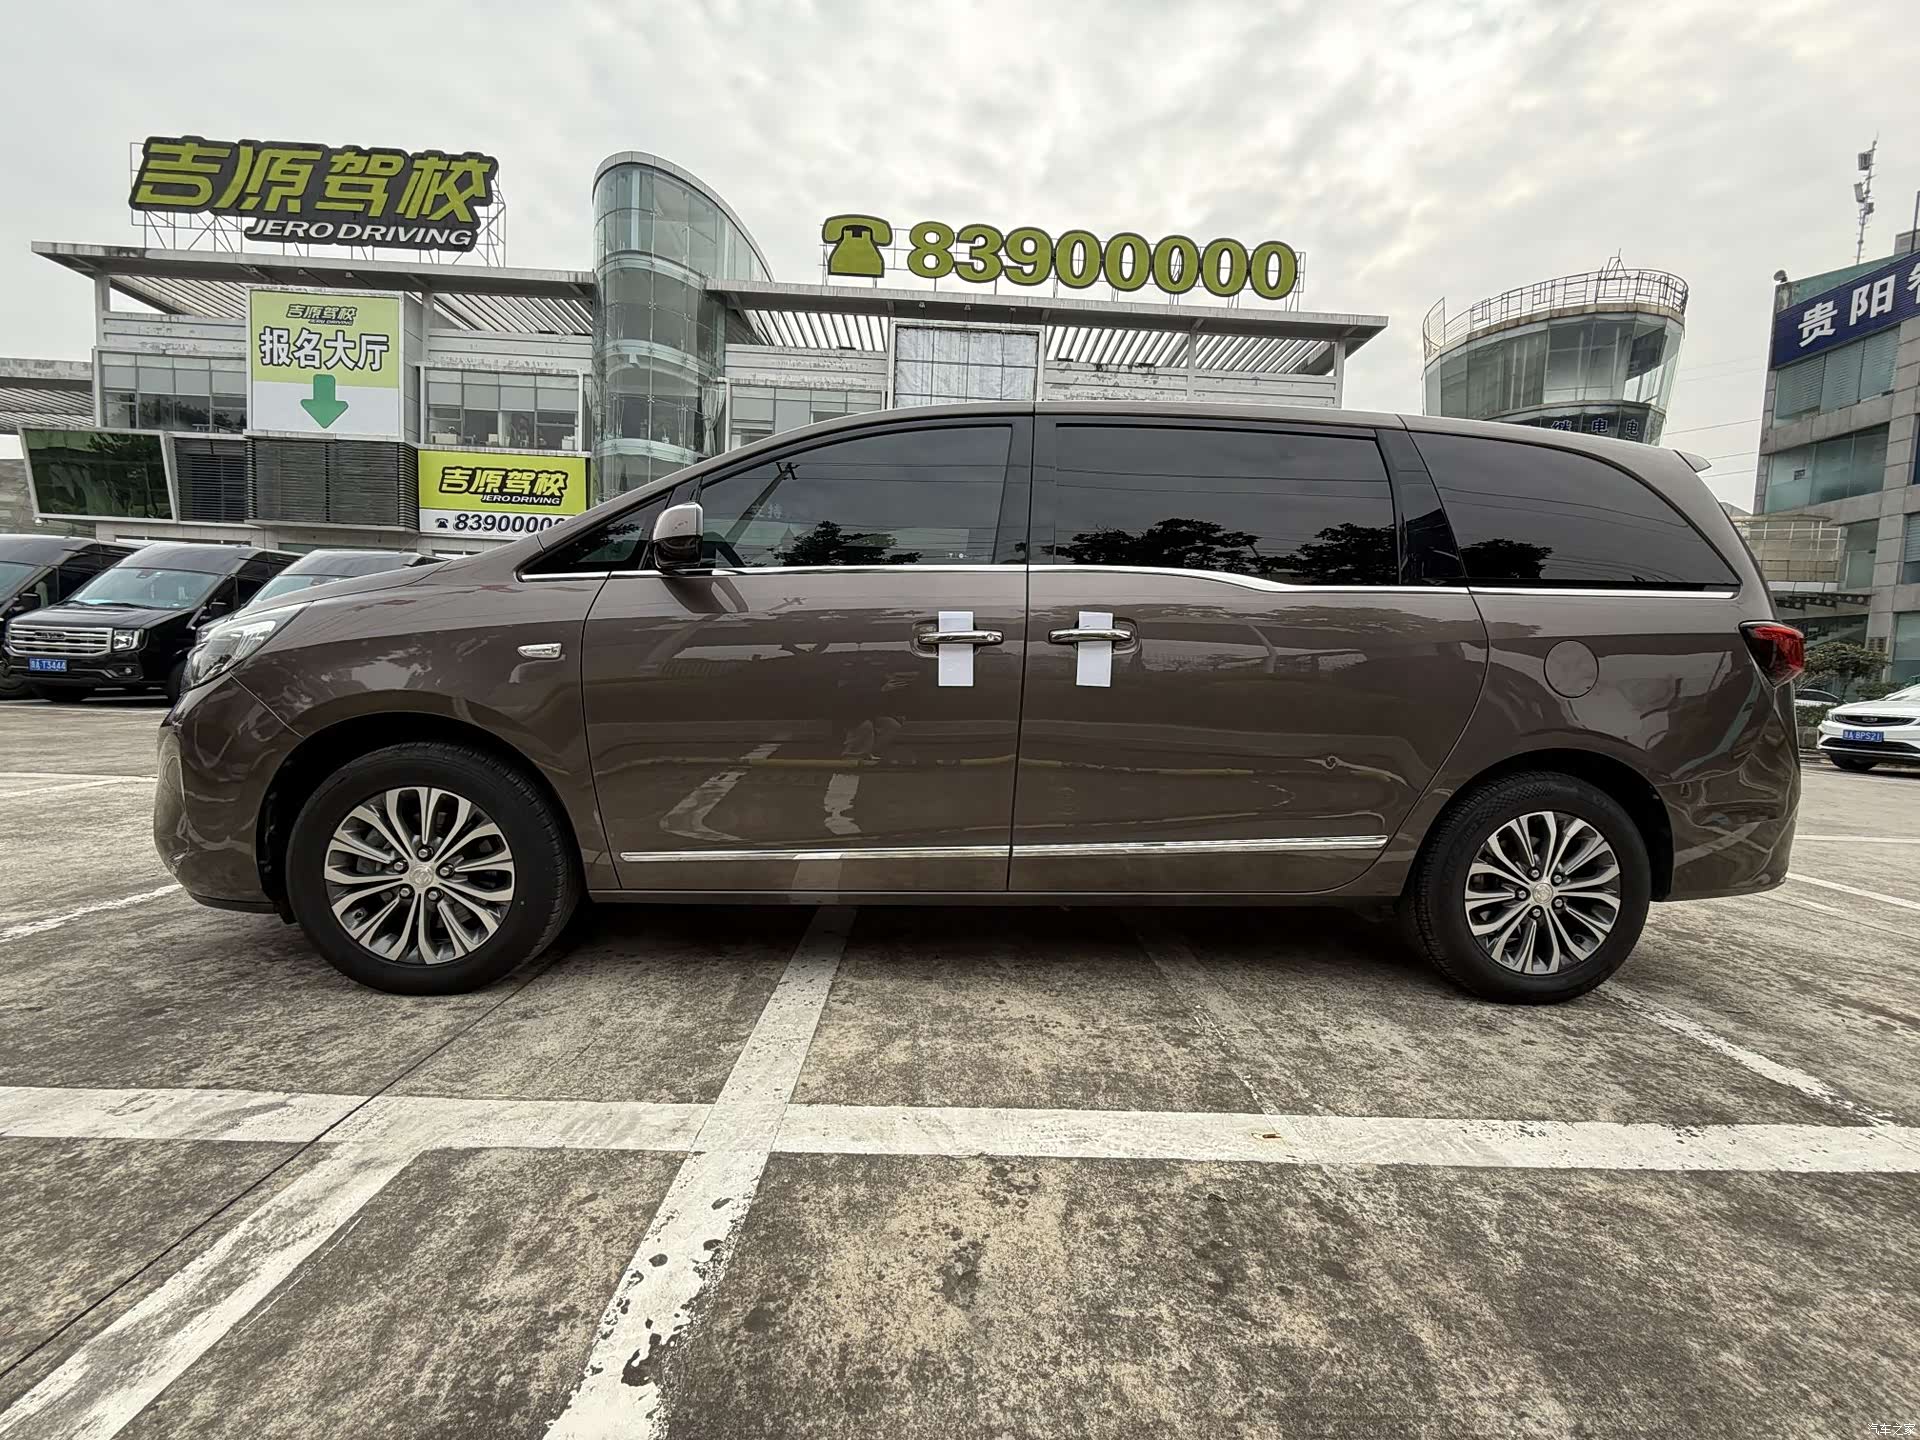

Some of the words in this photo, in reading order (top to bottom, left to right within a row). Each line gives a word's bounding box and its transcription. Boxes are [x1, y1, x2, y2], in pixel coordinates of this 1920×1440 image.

[134, 142, 494, 223] 吉原驾校
[249, 218, 332, 239] JERO
[337, 224, 473, 247] DRIVING
[906, 220, 1298, 300] 83900000
[286, 303, 358, 321] 吉原驾校
[259, 326, 389, 371] 报名大厅
[440, 467, 568, 497] 吉原驾校
[482, 494, 510, 503] JERO
[511, 495, 560, 505] DRIVING
